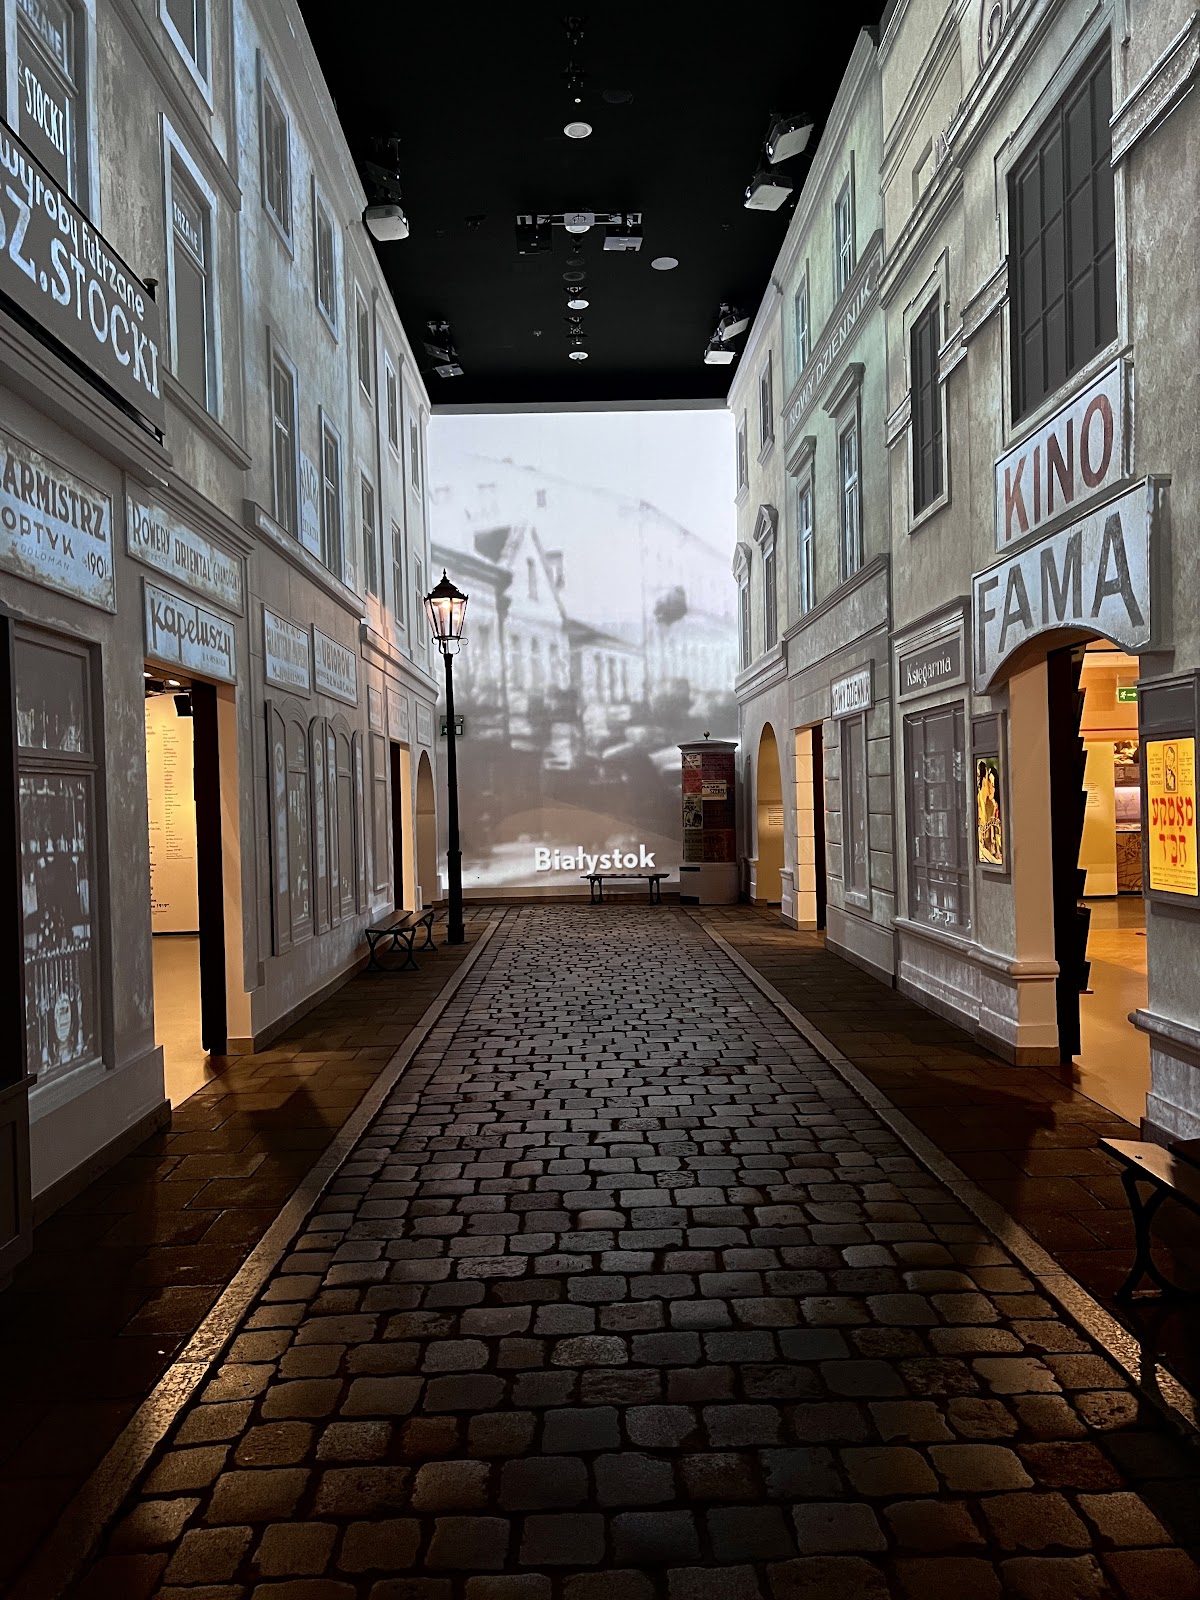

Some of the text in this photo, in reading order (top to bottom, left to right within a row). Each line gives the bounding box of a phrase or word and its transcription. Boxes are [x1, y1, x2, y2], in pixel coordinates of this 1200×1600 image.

[25, 66, 65, 156] STOCKI
[0, 132, 145, 322] wyroby futrzane
[816, 277, 871, 382] DZIENNIK
[0, 450, 107, 543] ARMISTRZ
[1004, 393, 1114, 542] KINO
[2, 506, 75, 560] OPTYK
[132, 501, 171, 556] ROWERY
[978, 510, 1145, 676] FAMA
[906, 651, 952, 688] Księgarnia
[534, 843, 657, 875] Białystok
